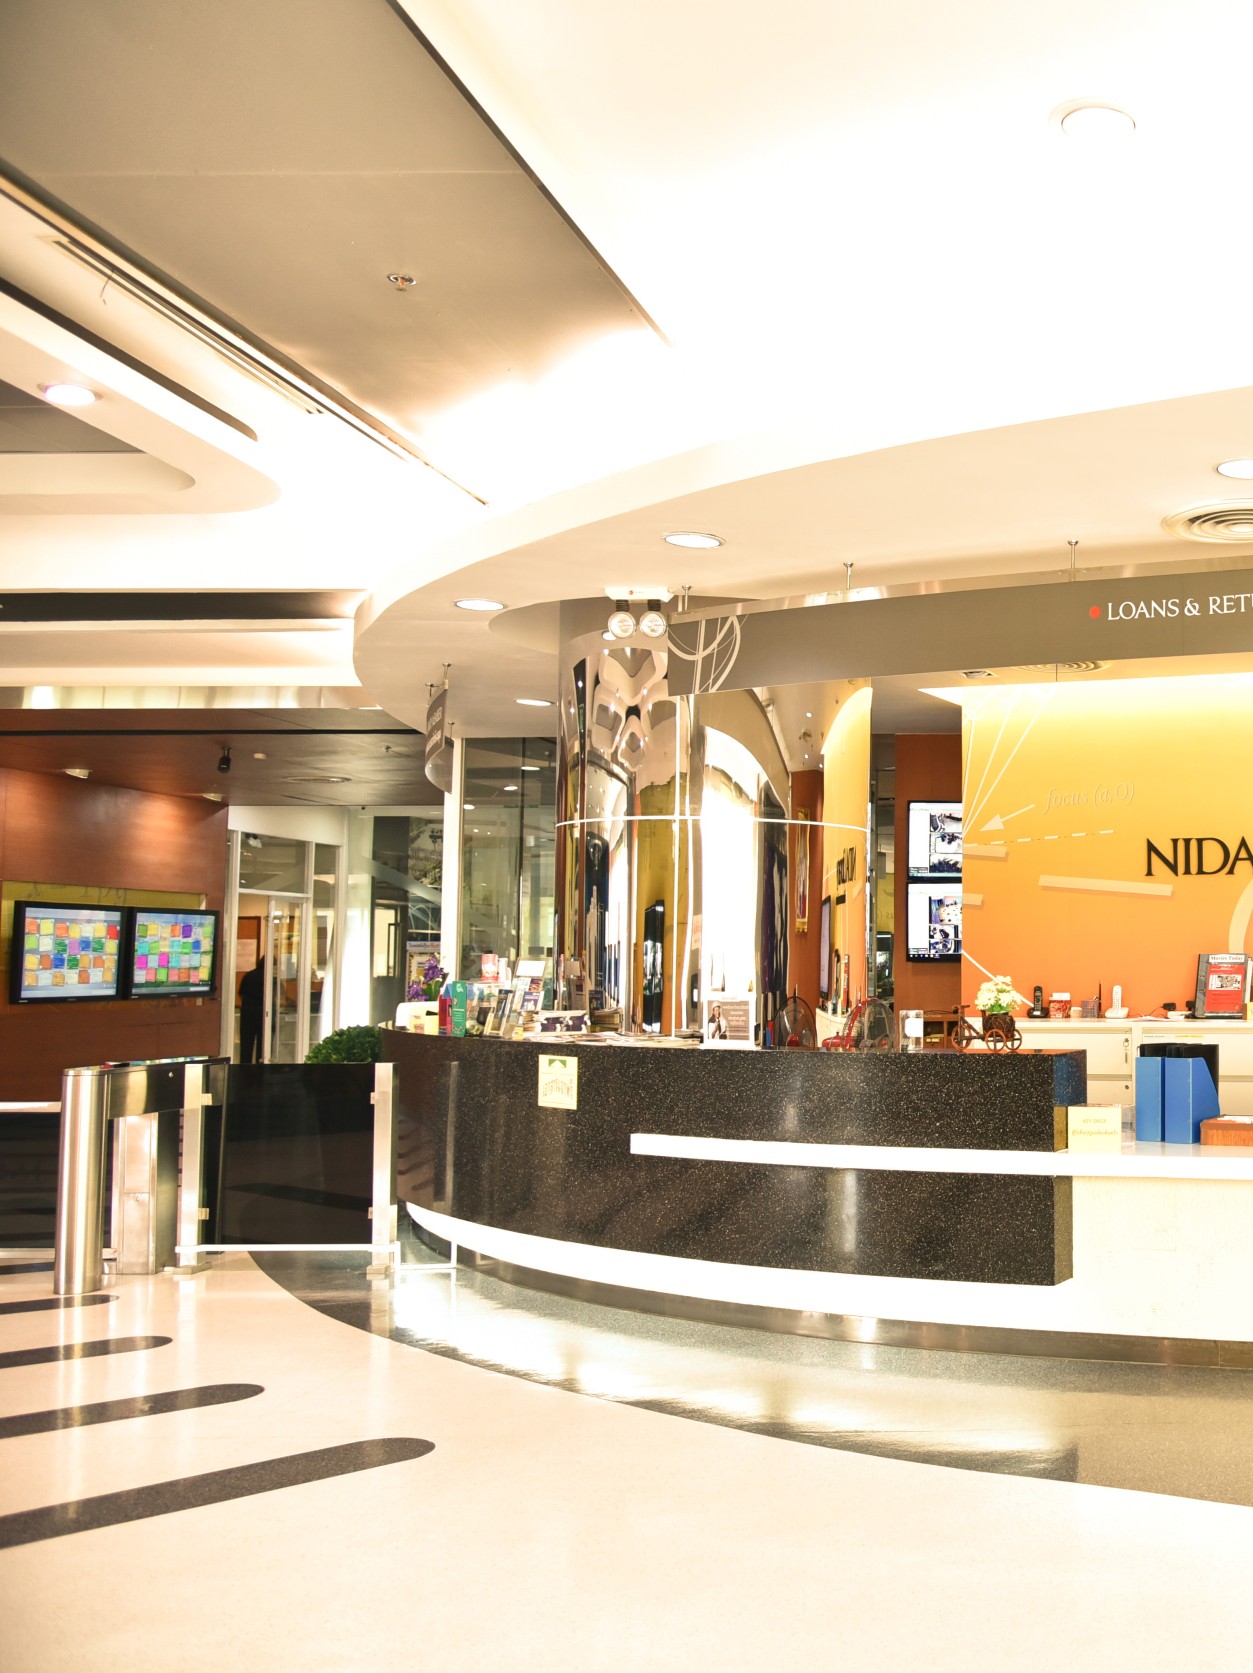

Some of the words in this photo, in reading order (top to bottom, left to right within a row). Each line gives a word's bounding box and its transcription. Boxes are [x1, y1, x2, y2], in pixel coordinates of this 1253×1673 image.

[1107, 598, 1180, 621] LOANS
[1184, 598, 1201, 616] &
[1041, 787, 1088, 816] focus
